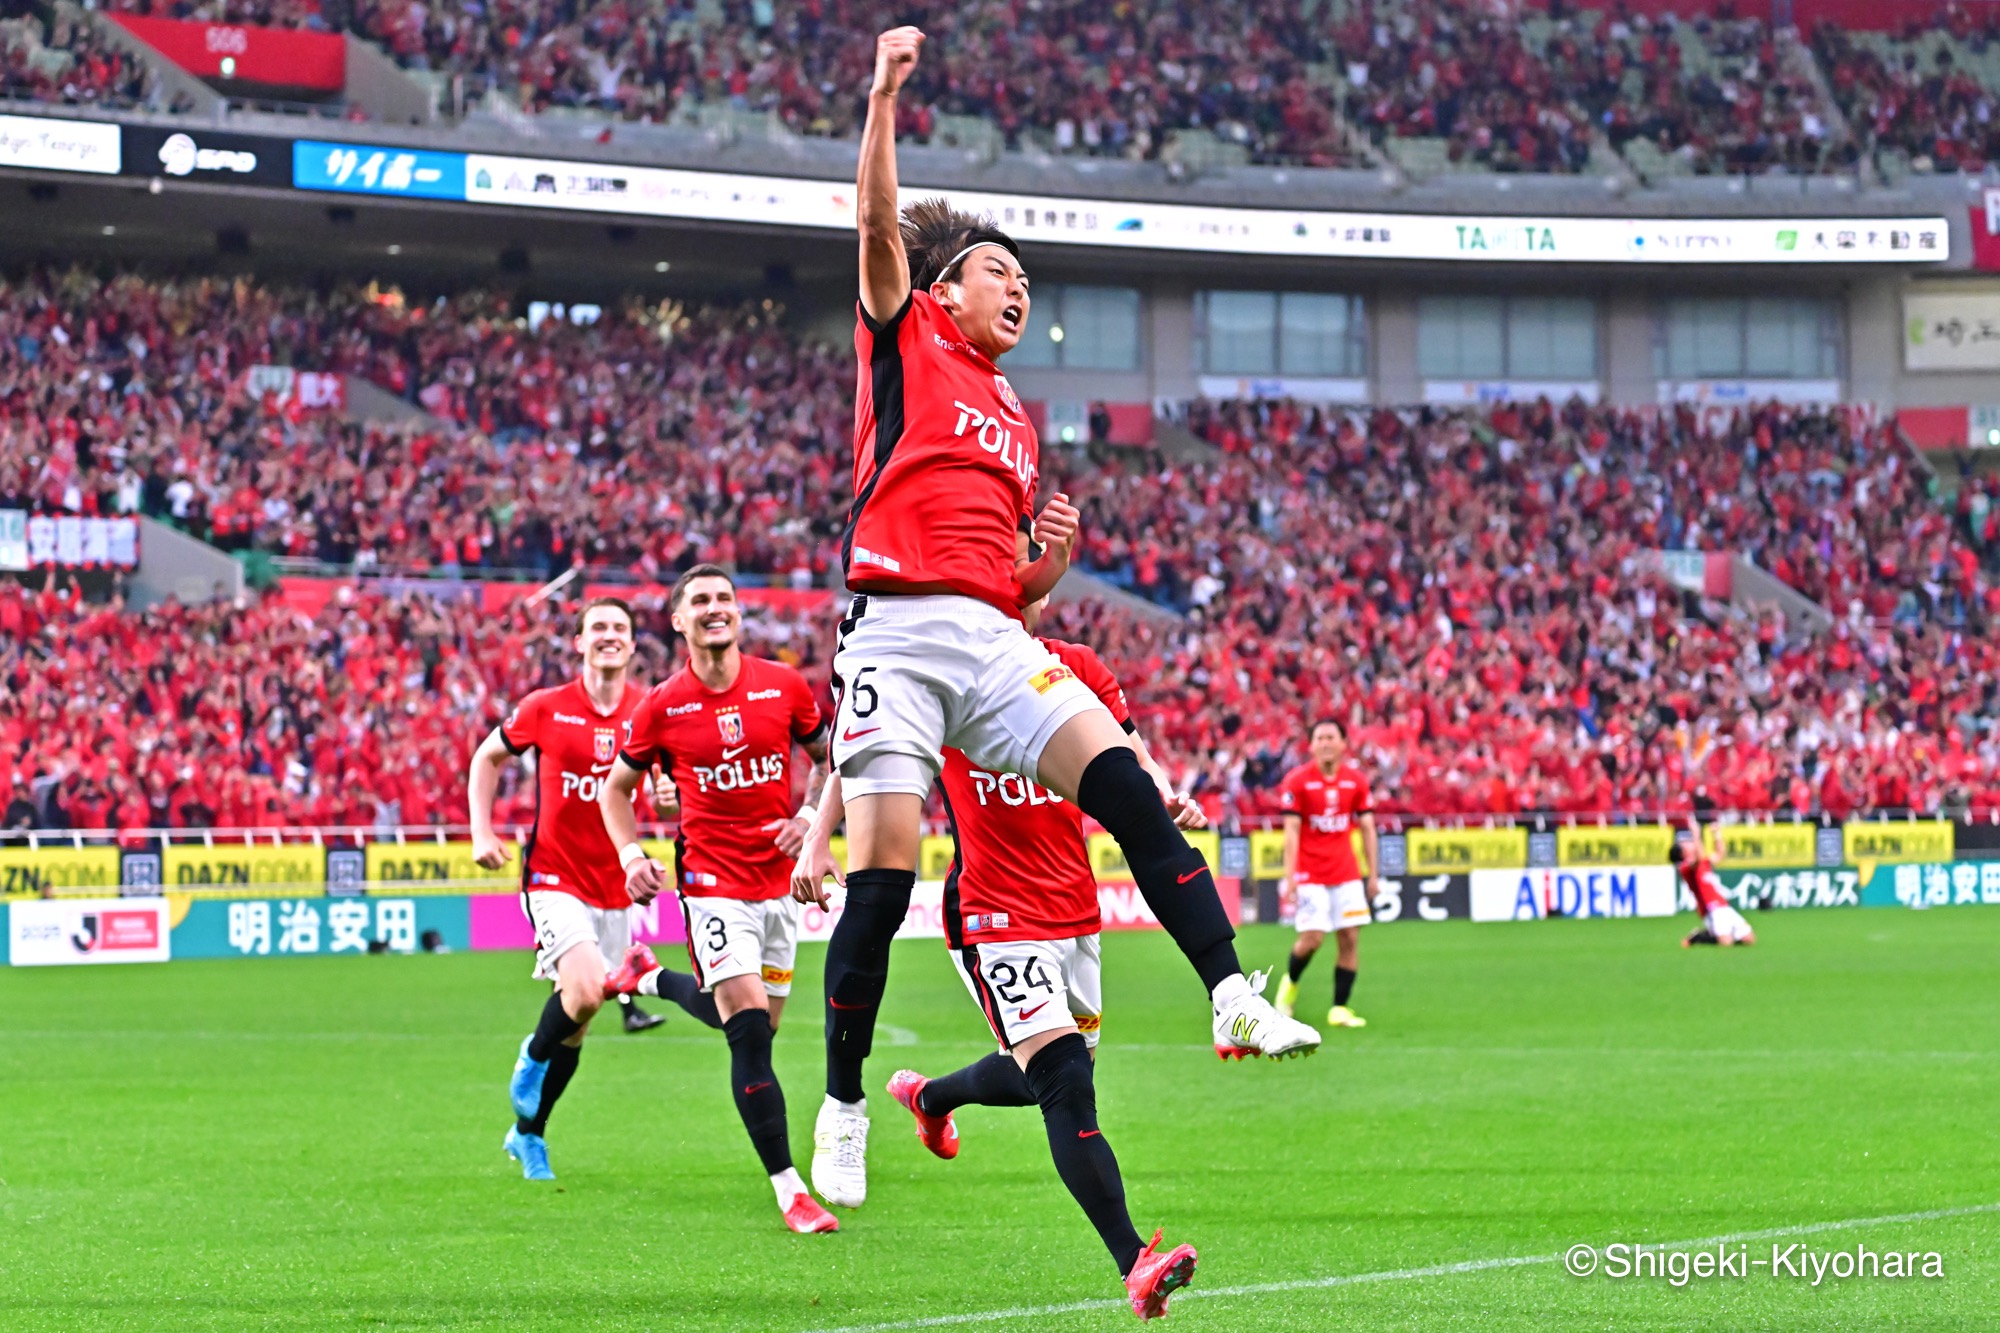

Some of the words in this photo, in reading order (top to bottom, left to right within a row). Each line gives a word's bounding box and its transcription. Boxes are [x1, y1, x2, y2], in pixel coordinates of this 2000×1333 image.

[852, 667, 878, 718] 6
[693, 753, 784, 793] POLUS
[969, 770, 1064, 807] POL
[1513, 873, 1637, 919] AiDEM
[706, 916, 727, 951] 3
[989, 955, 1054, 1004] 24
